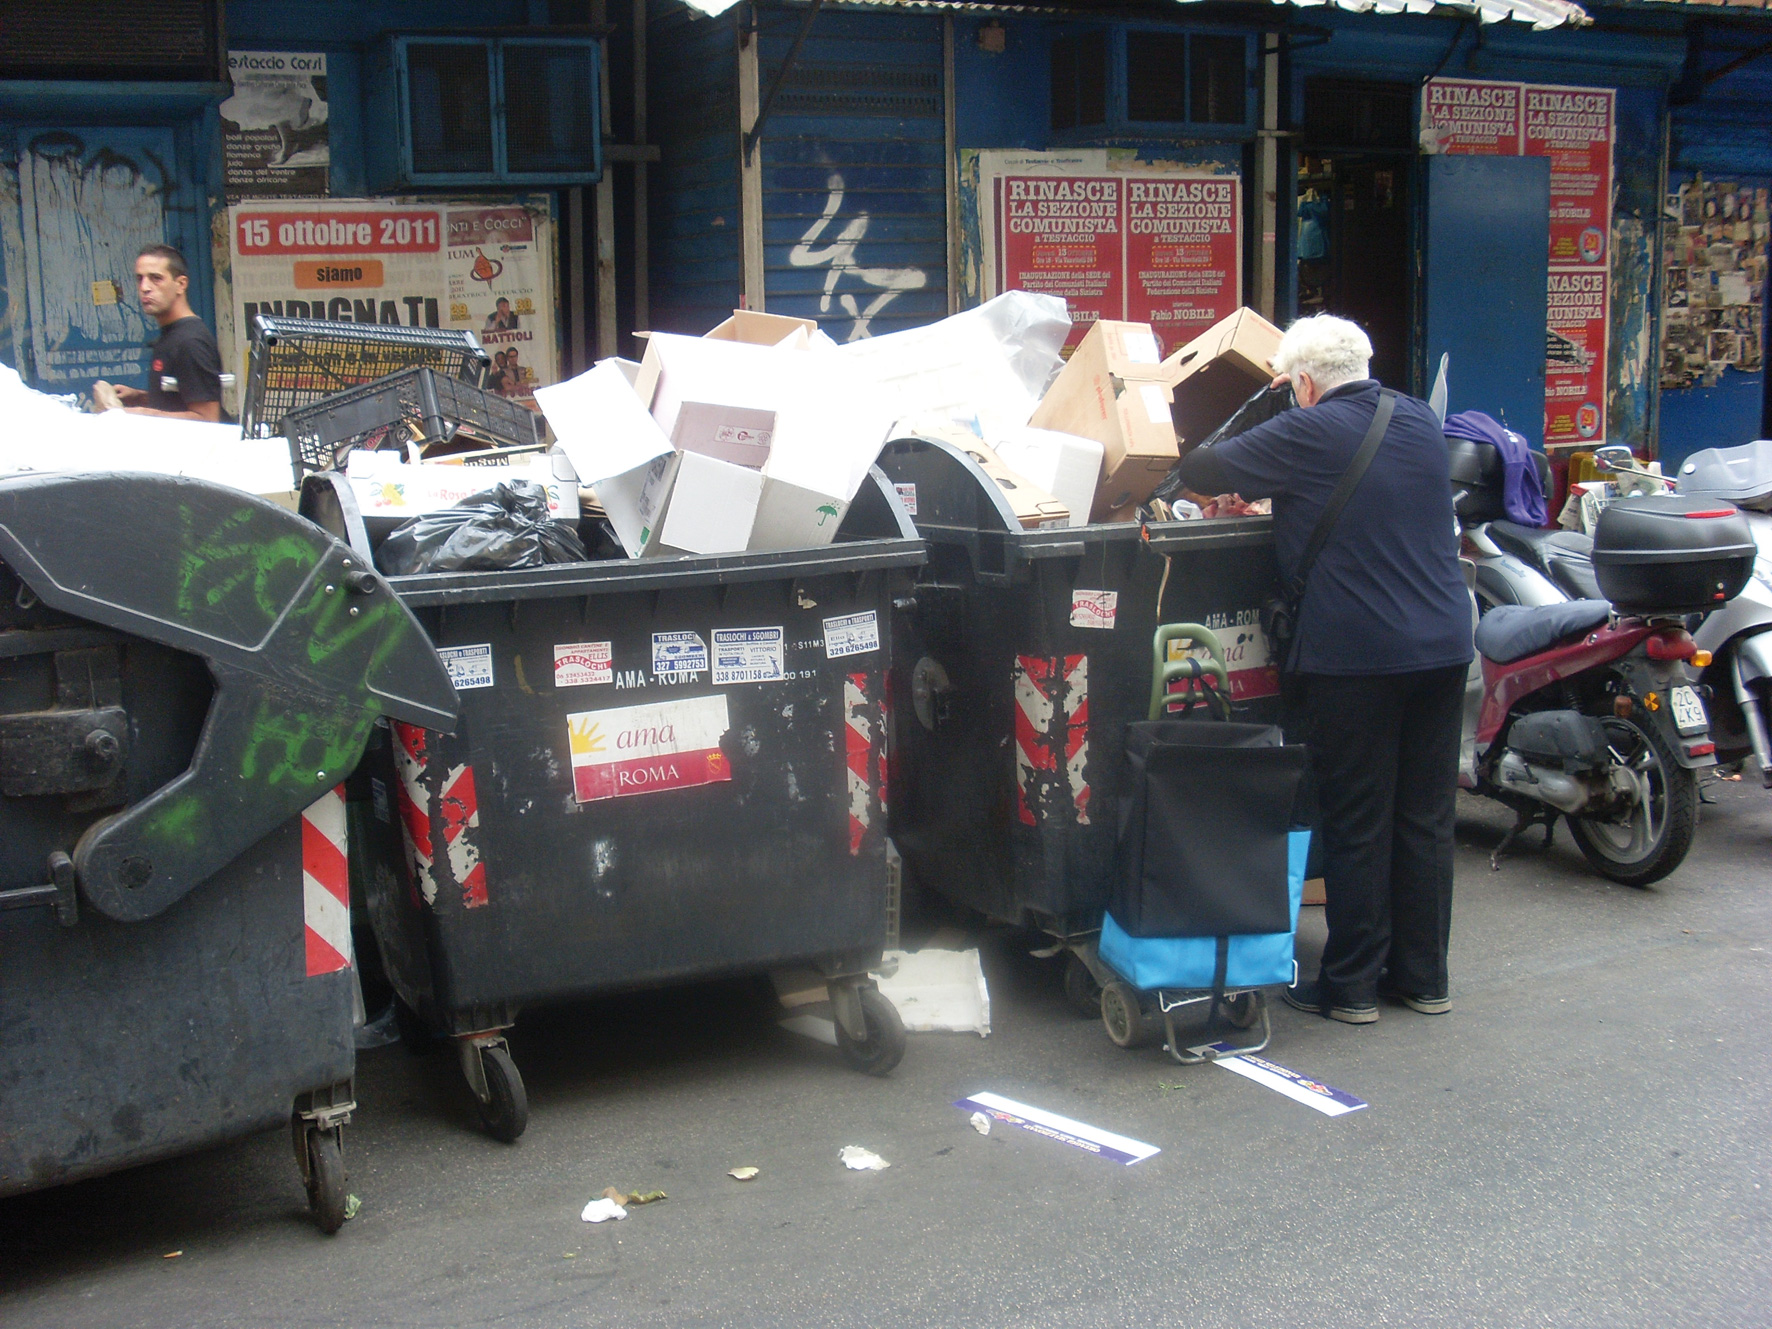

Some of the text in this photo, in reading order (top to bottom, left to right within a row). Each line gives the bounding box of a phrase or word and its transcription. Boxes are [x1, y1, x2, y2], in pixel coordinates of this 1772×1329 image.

[1431, 86, 1516, 108] RINASCE
[1528, 92, 1607, 113] RINASCE
[1431, 105, 1516, 122] LA SEZIONE
[1528, 111, 1607, 127] LA SEZIONE
[1528, 126, 1607, 142] COMUNISTA
[1009, 181, 1117, 200] RINASCE
[1130, 183, 1231, 202] RINASCE
[1009, 202, 1117, 217] LA SEZIONE
[1130, 203, 1231, 218] LA SEZIONE
[1558, 208, 1591, 218] NOBILE
[240, 218, 437, 247] 15 ottobre 2011
[1009, 218, 1118, 233] COMUNISTA
[1130, 219, 1232, 234] COMUNISTA
[1042, 234, 1095, 243] TESTACCIO
[1161, 234, 1211, 243] TESTACCIO
[1058, 248, 1067, 256] 13
[1176, 248, 1185, 256] 13
[316, 266, 363, 282] siamo
[1019, 271, 1071, 280] INAUGURAZIONE
[1023, 280, 1044, 289] Partito
[1055, 279, 1084, 288] Comunisti
[1142, 280, 1162, 288] Partito
[1172, 279, 1201, 287] Comunisti
[1147, 287, 1181, 296] Federazione
[1151, 309, 1215, 321] Fabio NOBILE
[482, 331, 533, 345] MATTIOLI
[1556, 386, 1588, 396] NOBILE
[1075, 600, 1113, 617] TRASLOCHI
[1206, 612, 1227, 629] AMA
[716, 631, 746, 642] TRASLOCHI
[830, 641, 878, 656] 329 6265498
[557, 655, 607, 670] TRASLOCHI
[656, 658, 704, 671] 327 5992753
[455, 675, 491, 688] 6265498
[616, 670, 699, 690] AMA ROMA
[716, 670, 762, 681] 338 8701158
[1676, 691, 1693, 706] 2C
[616, 724, 675, 749] ama
[619, 764, 679, 786] ROMA
